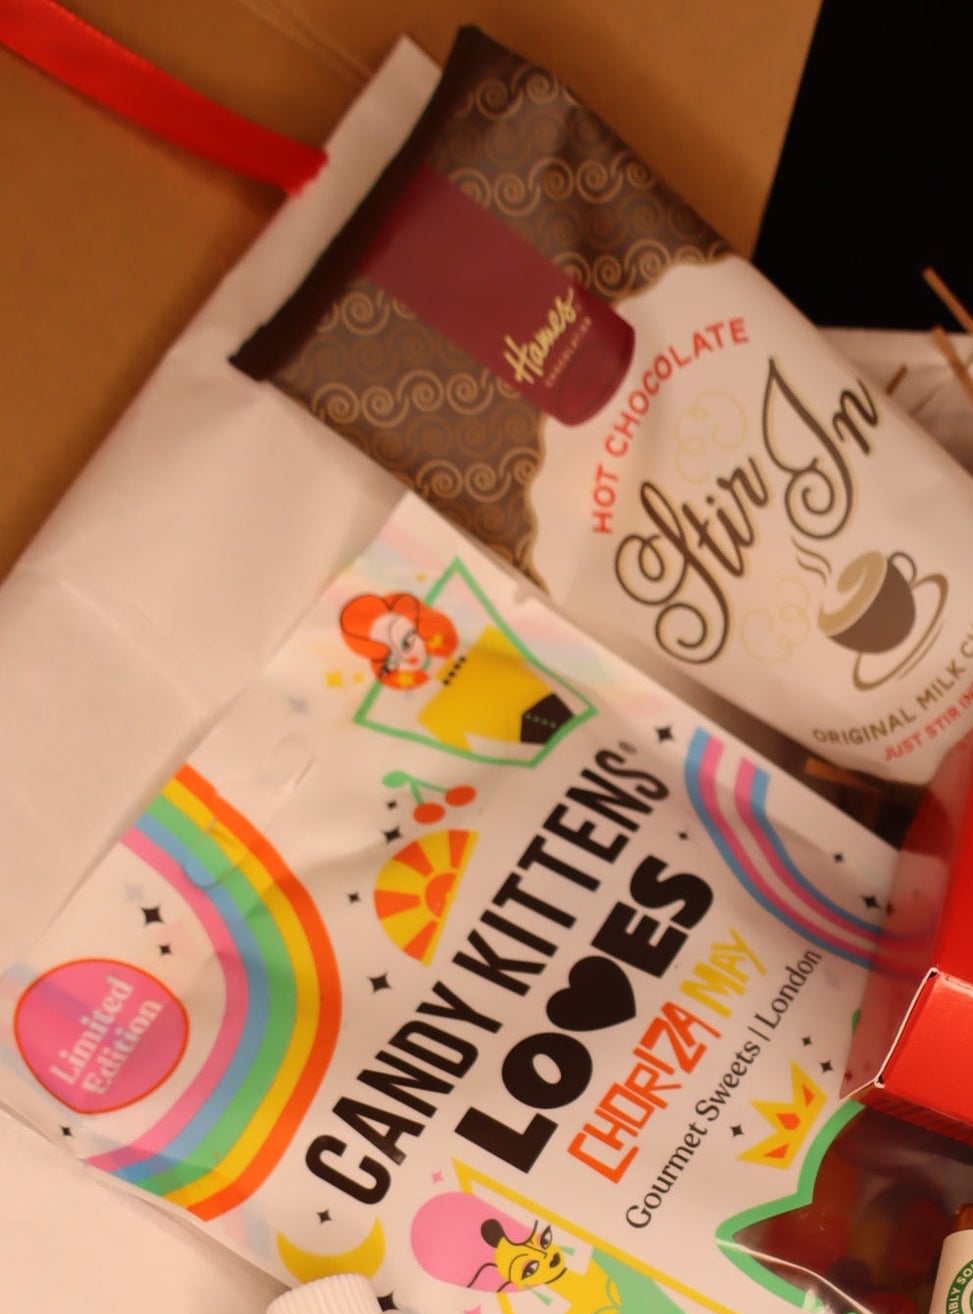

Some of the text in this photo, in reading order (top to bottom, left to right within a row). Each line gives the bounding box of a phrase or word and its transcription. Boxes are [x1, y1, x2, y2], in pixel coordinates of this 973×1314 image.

[591, 316, 750, 535] HOT CHOCOLATE
[614, 356, 881, 664] Stir In
[811, 705, 918, 746] ORIGINAL
[915, 658, 967, 711] MILK
[884, 731, 924, 762] JUST
[924, 706, 961, 740] STIR
[679, 926, 768, 1019] MAY
[49, 973, 135, 1085] Limited
[81, 998, 163, 1095] Edition
[304, 980, 504, 1206] CANDY
[625, 1121, 709, 1230] Gourmet
[695, 1034, 764, 1122] Sweets
[754, 949, 823, 1031] London
